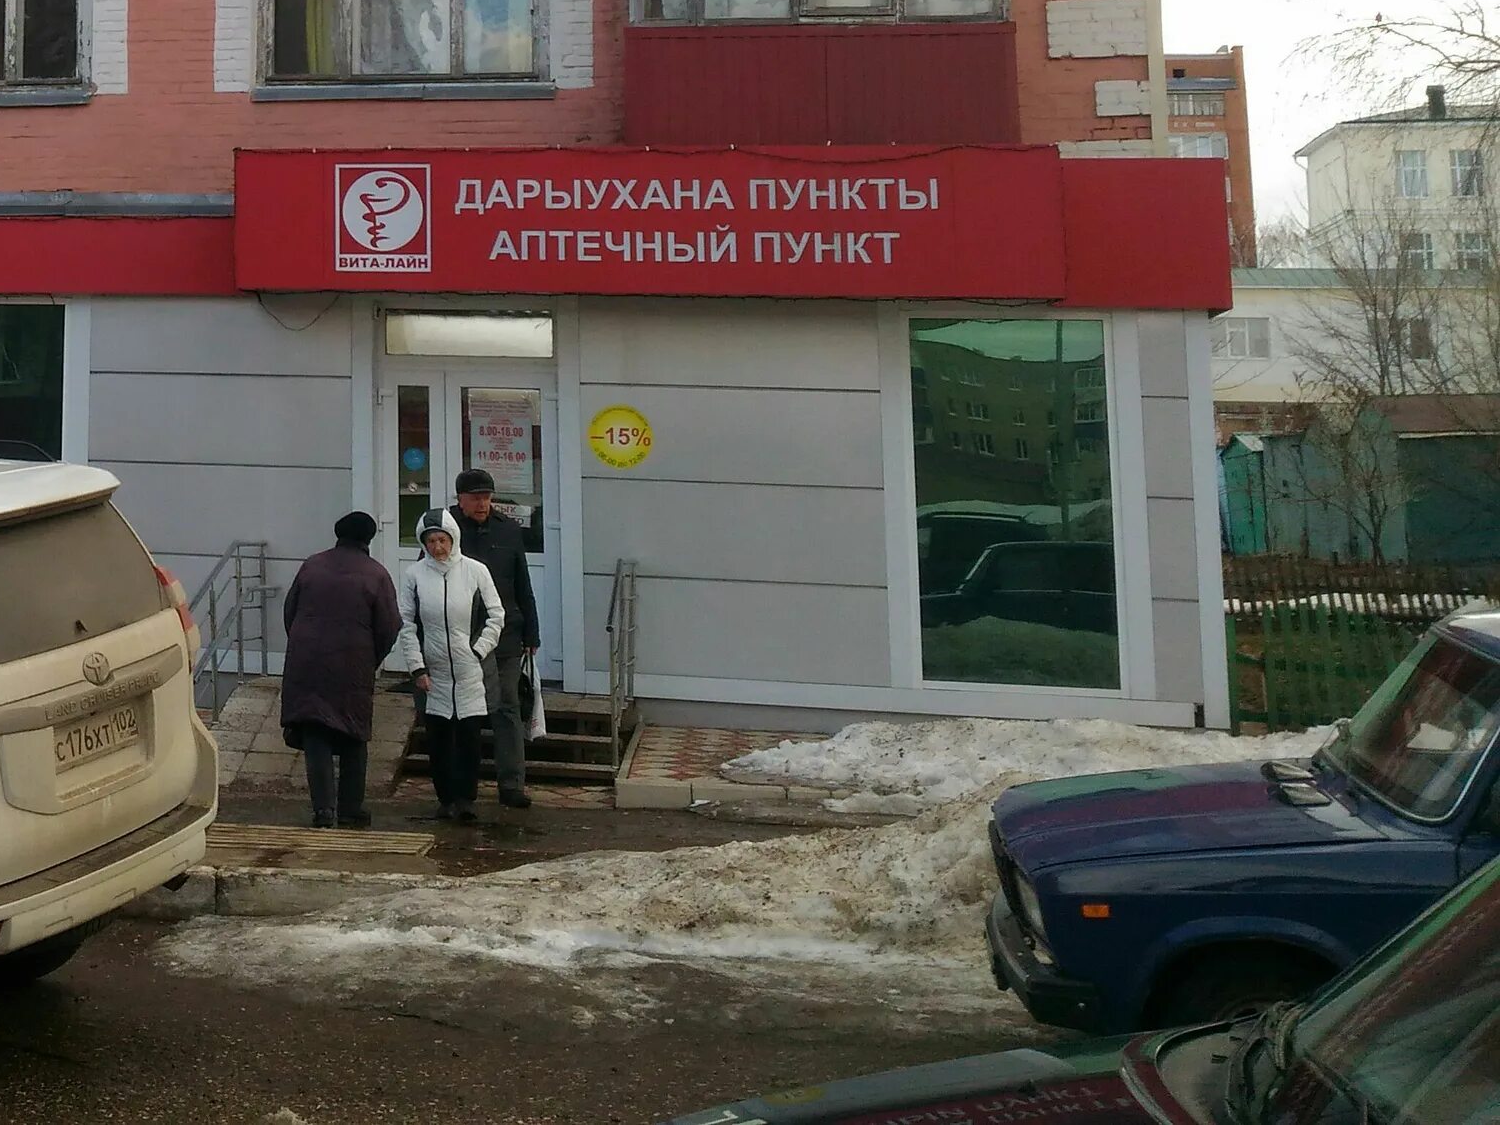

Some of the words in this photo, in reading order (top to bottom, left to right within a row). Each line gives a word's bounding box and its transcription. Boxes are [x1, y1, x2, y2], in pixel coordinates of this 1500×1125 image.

[454, 179, 735, 215] ДАРЫУХАНА
[749, 178, 939, 211] ПУНКТЫ
[488, 224, 738, 263] АПТЕЧНЫЙ
[754, 232, 901, 264] ПУНКТ
[338, 256, 429, 269] ВИТА-ЛАЙН
[112, 708, 137, 733] 102
